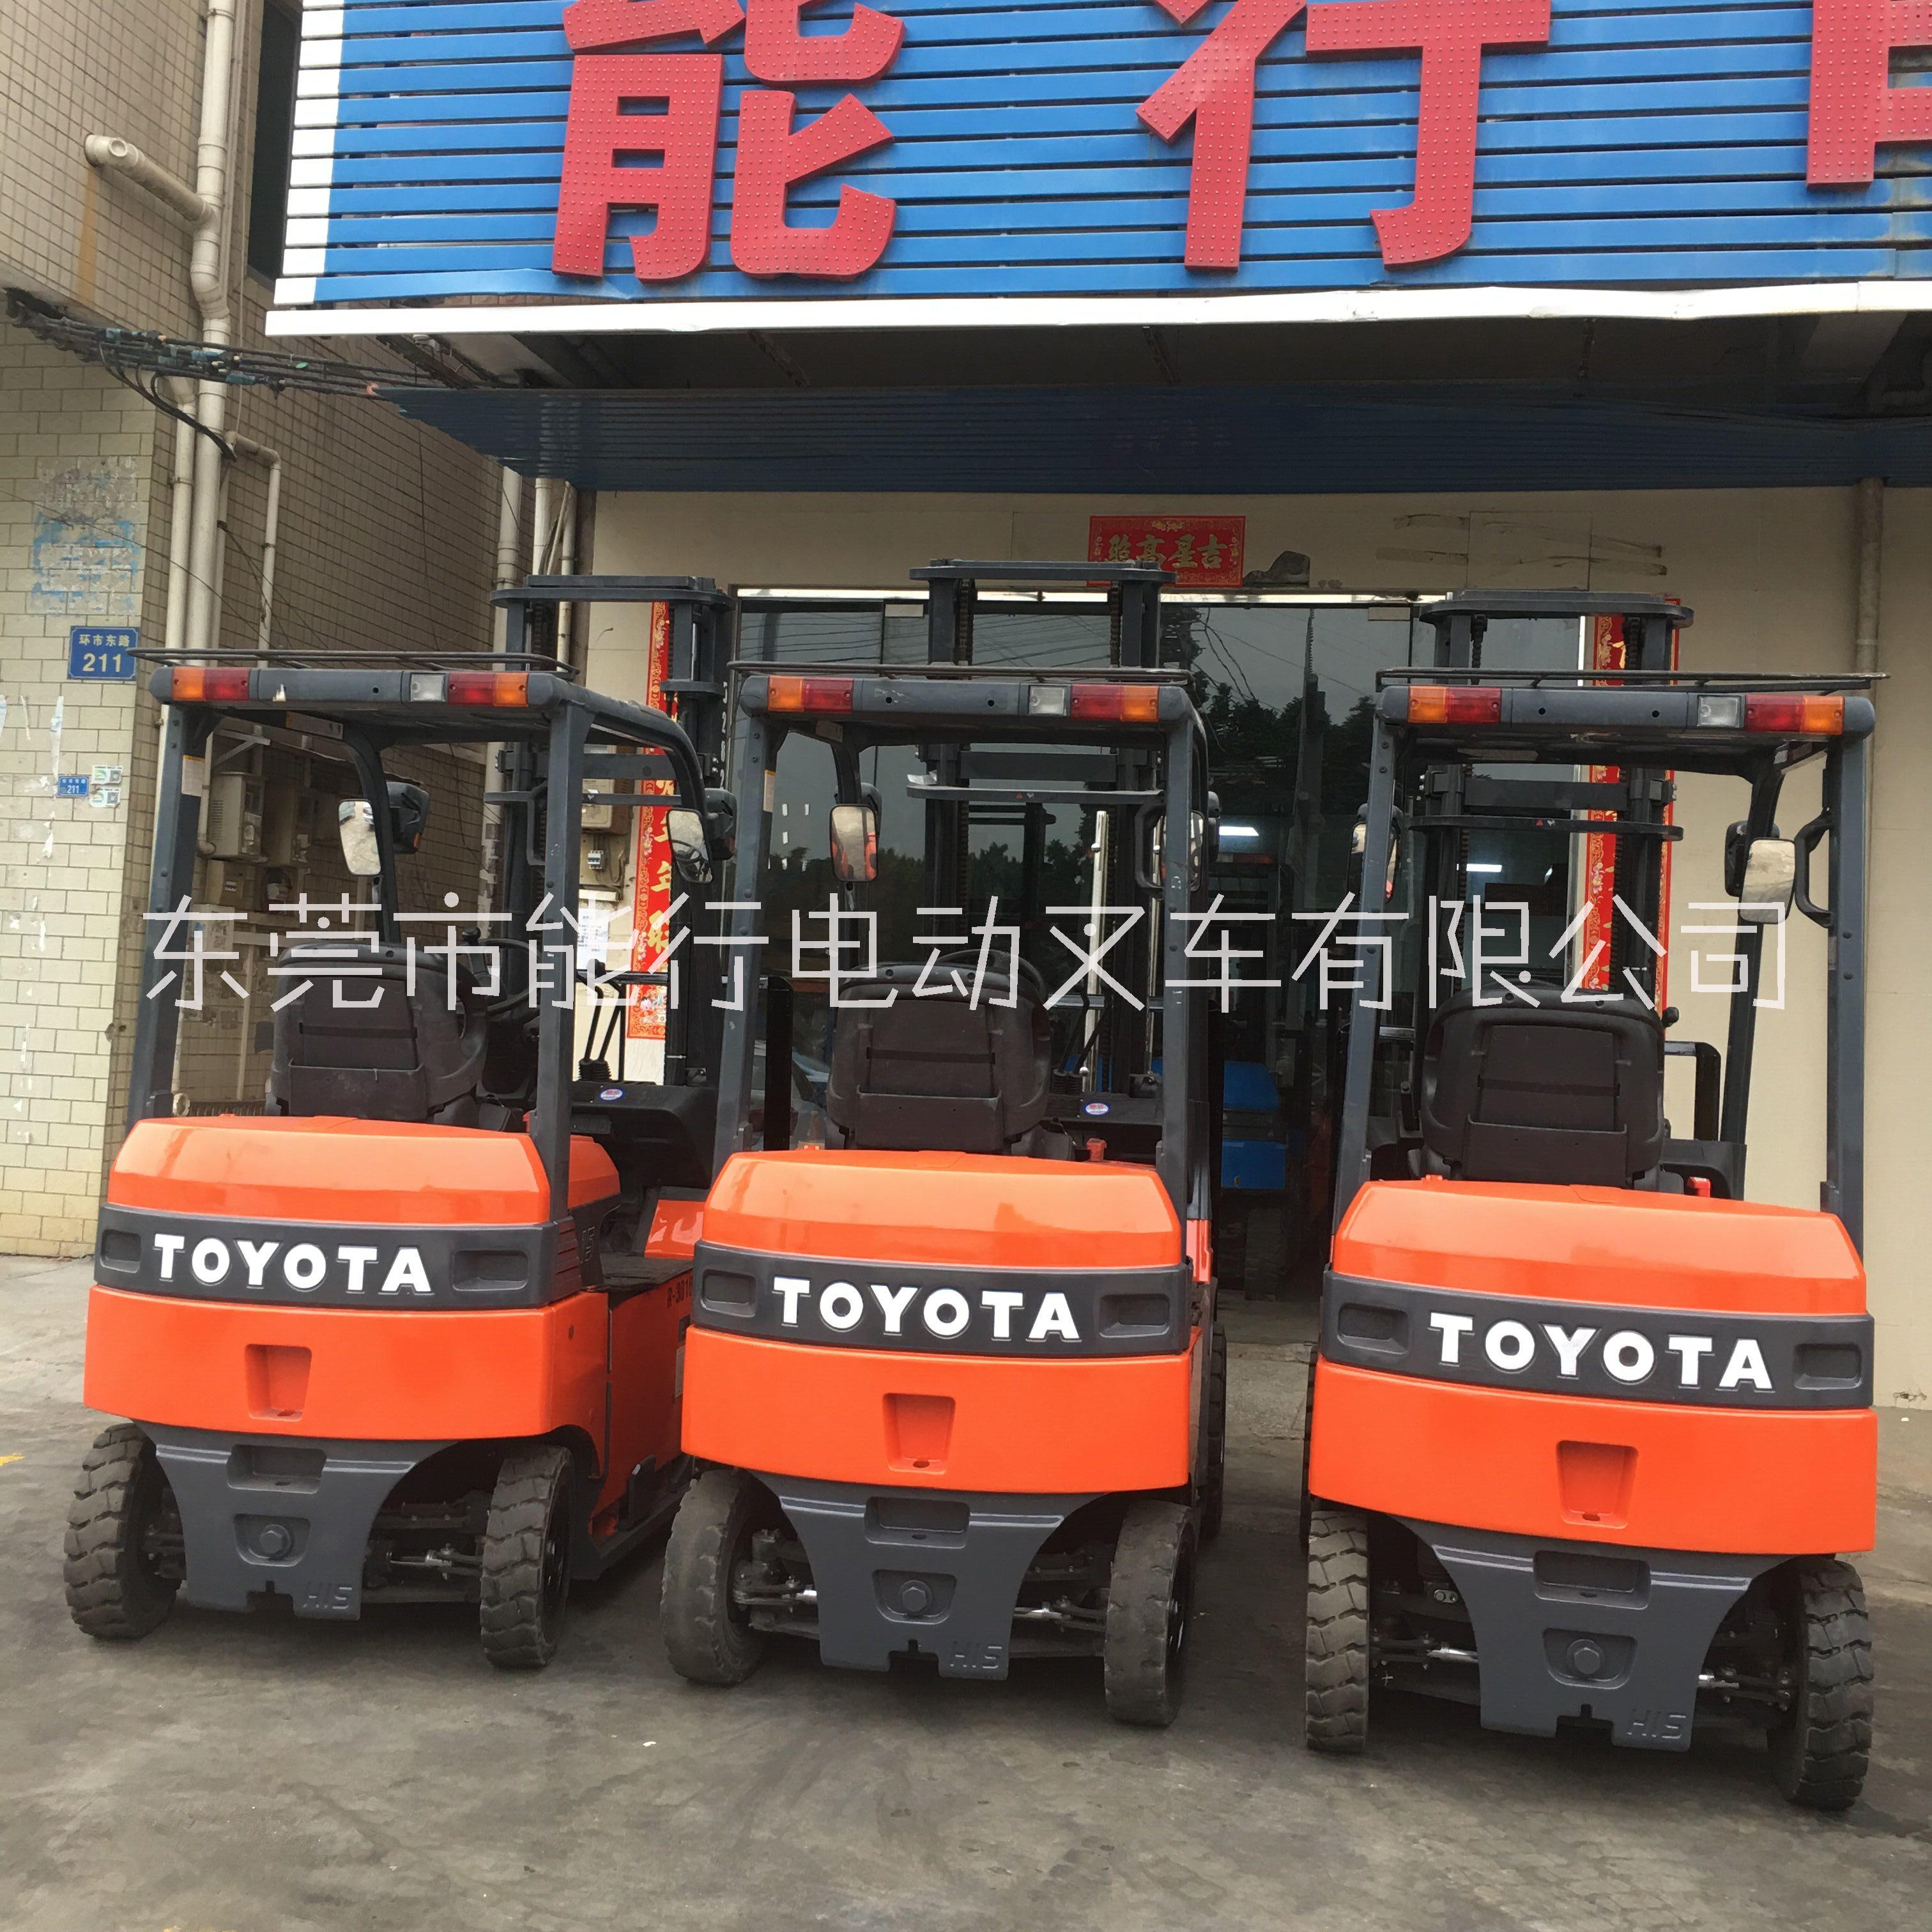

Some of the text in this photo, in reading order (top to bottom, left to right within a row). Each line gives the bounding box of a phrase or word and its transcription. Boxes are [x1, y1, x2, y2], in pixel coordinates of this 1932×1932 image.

[79, 634, 130, 647] 环市东路
[82, 652, 121, 673] 211
[66, 785, 80, 794] 211
[155, 1233, 433, 1294] TOYOTA
[773, 1276, 1081, 1342] TOYOTA
[1430, 1312, 1774, 1392] TOYOTA
